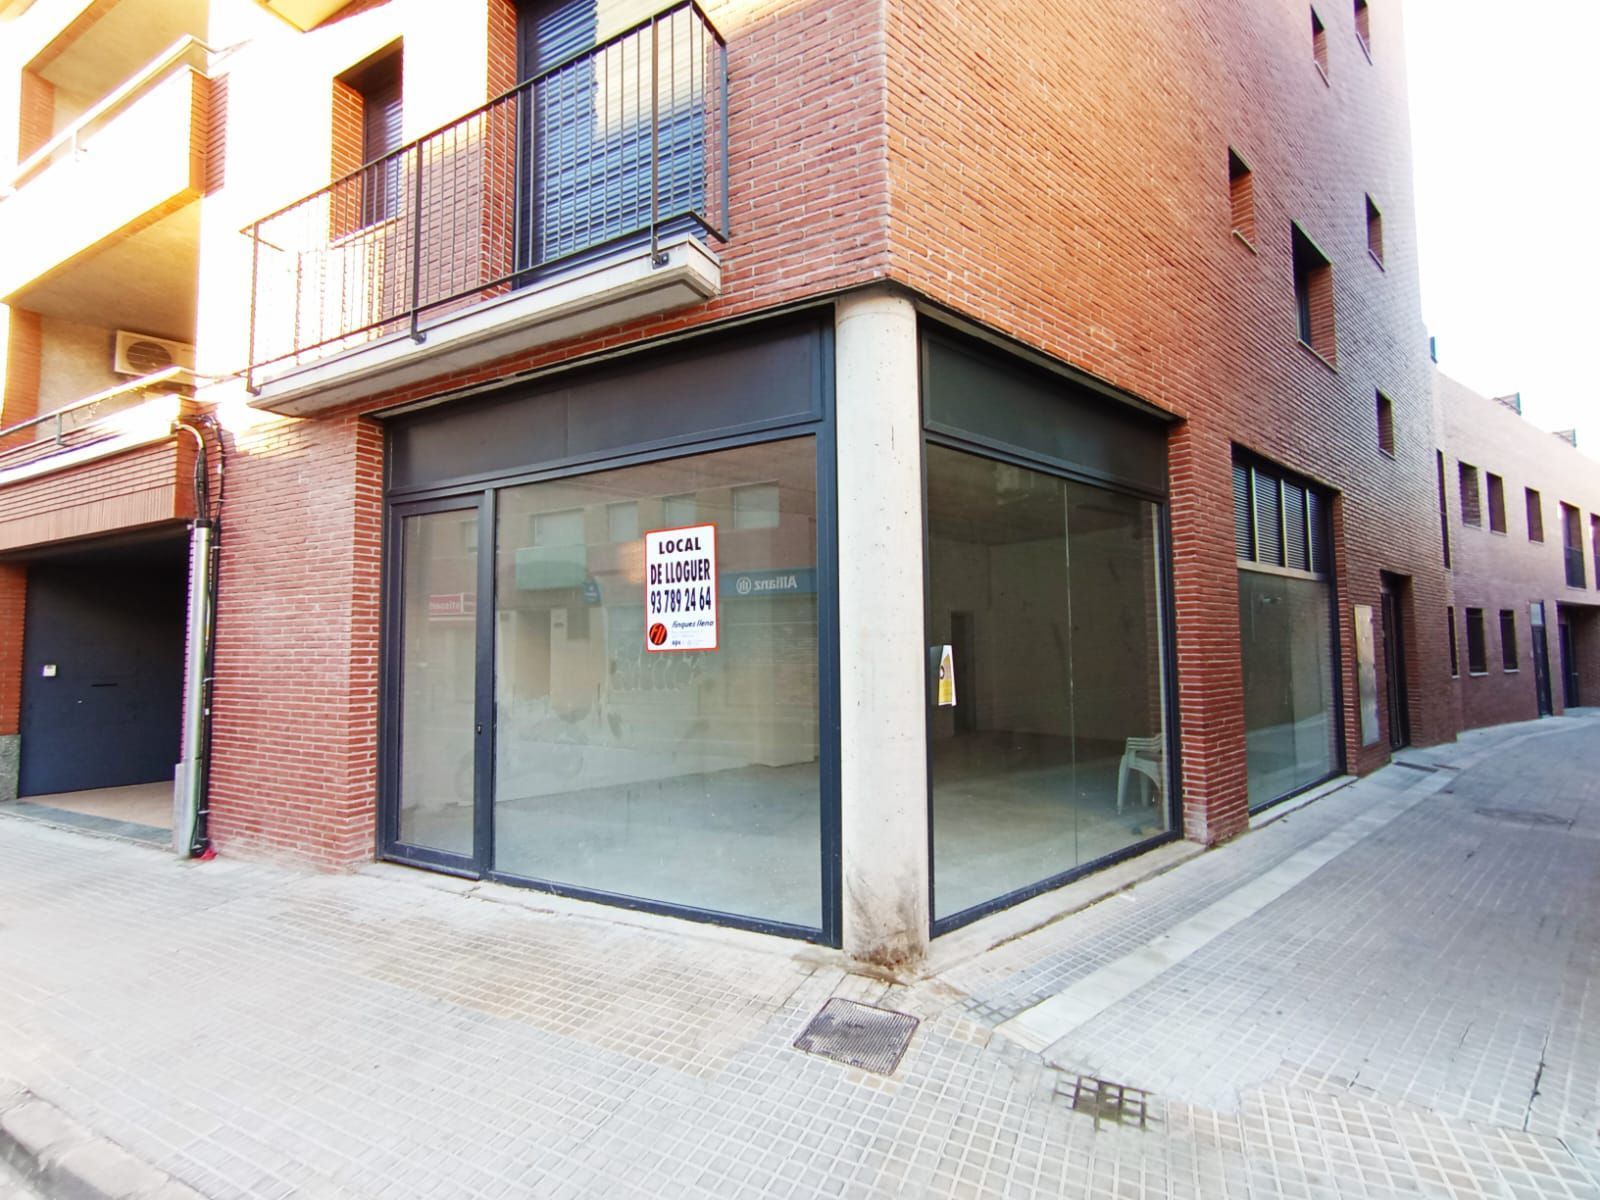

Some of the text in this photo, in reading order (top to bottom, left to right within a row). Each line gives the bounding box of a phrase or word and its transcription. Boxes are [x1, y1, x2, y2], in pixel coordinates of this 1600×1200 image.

[659, 537, 701, 554] LOCAL
[650, 558, 711, 585] DE LLOGUER
[650, 586, 711, 614] 93 789 24 64
